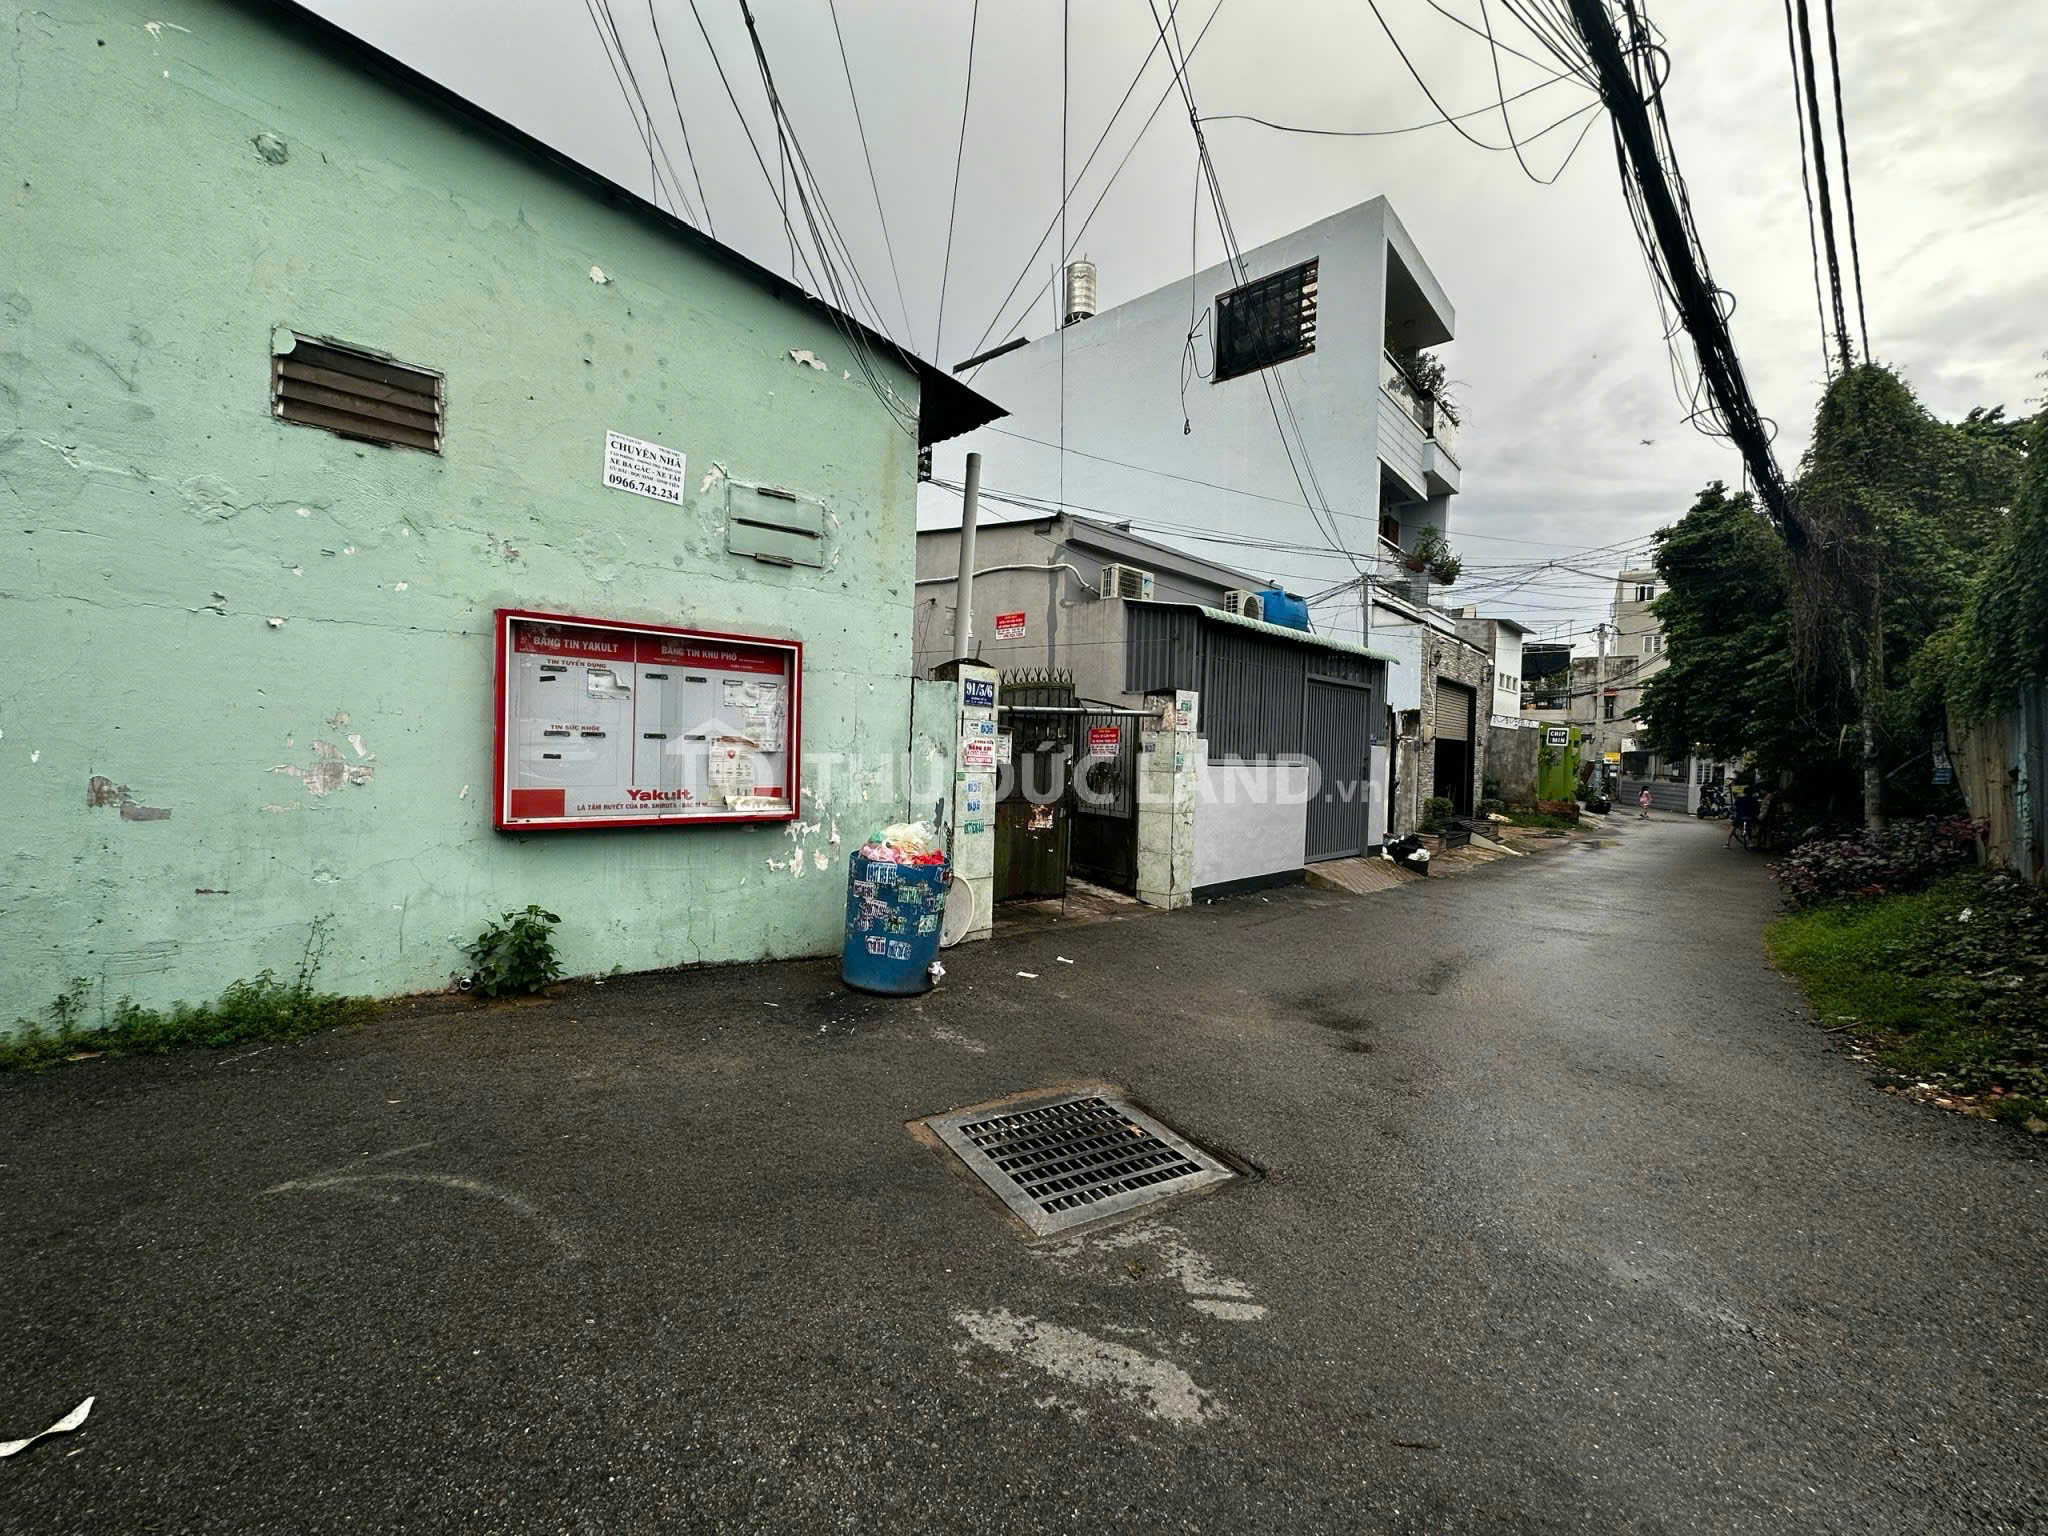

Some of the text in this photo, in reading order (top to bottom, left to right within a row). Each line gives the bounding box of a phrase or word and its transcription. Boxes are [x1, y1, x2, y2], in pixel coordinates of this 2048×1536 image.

[610, 457, 620, 465] XE
[622, 460, 632, 469] BA
[657, 470, 667, 479] XE
[609, 473, 679, 501] 0966.742.234
[563, 639, 581, 649] TIN
[582, 640, 619, 653] YAKULT
[686, 649, 700, 657] TIN
[702, 650, 719, 659] KHU
[966, 681, 993, 698] 91/5/6
[626, 788, 694, 801] Yakult
